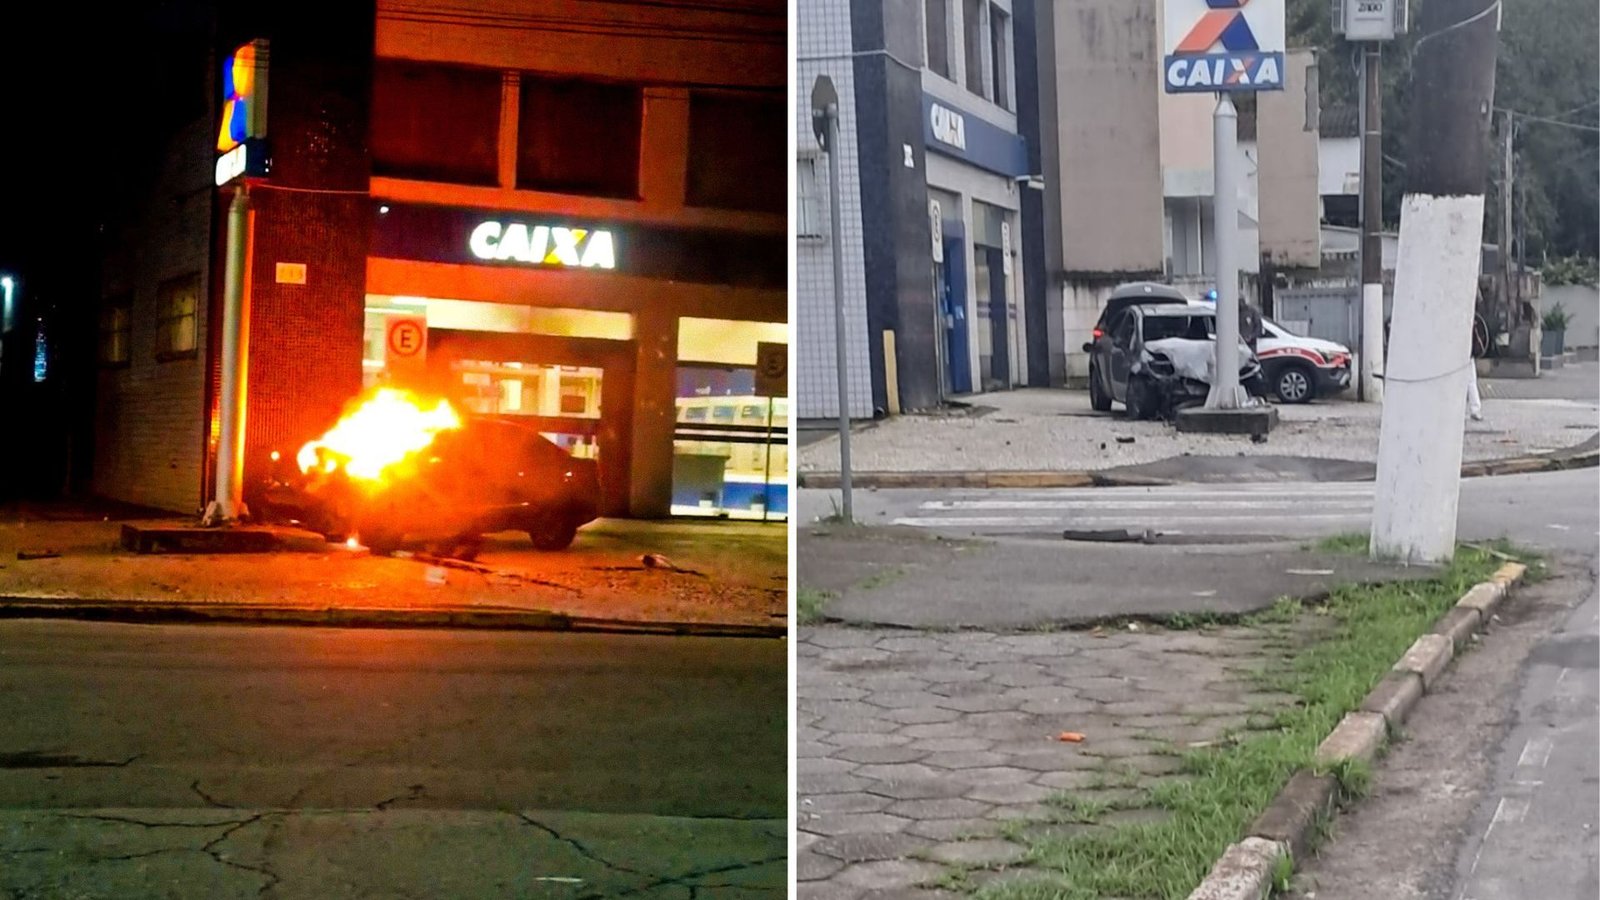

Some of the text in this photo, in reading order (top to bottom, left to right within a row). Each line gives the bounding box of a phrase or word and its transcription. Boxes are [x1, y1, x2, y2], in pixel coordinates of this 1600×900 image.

[1167, 57, 1280, 87] CAIXA
[469, 220, 616, 269] CAIXA
[400, 328, 412, 348] E
